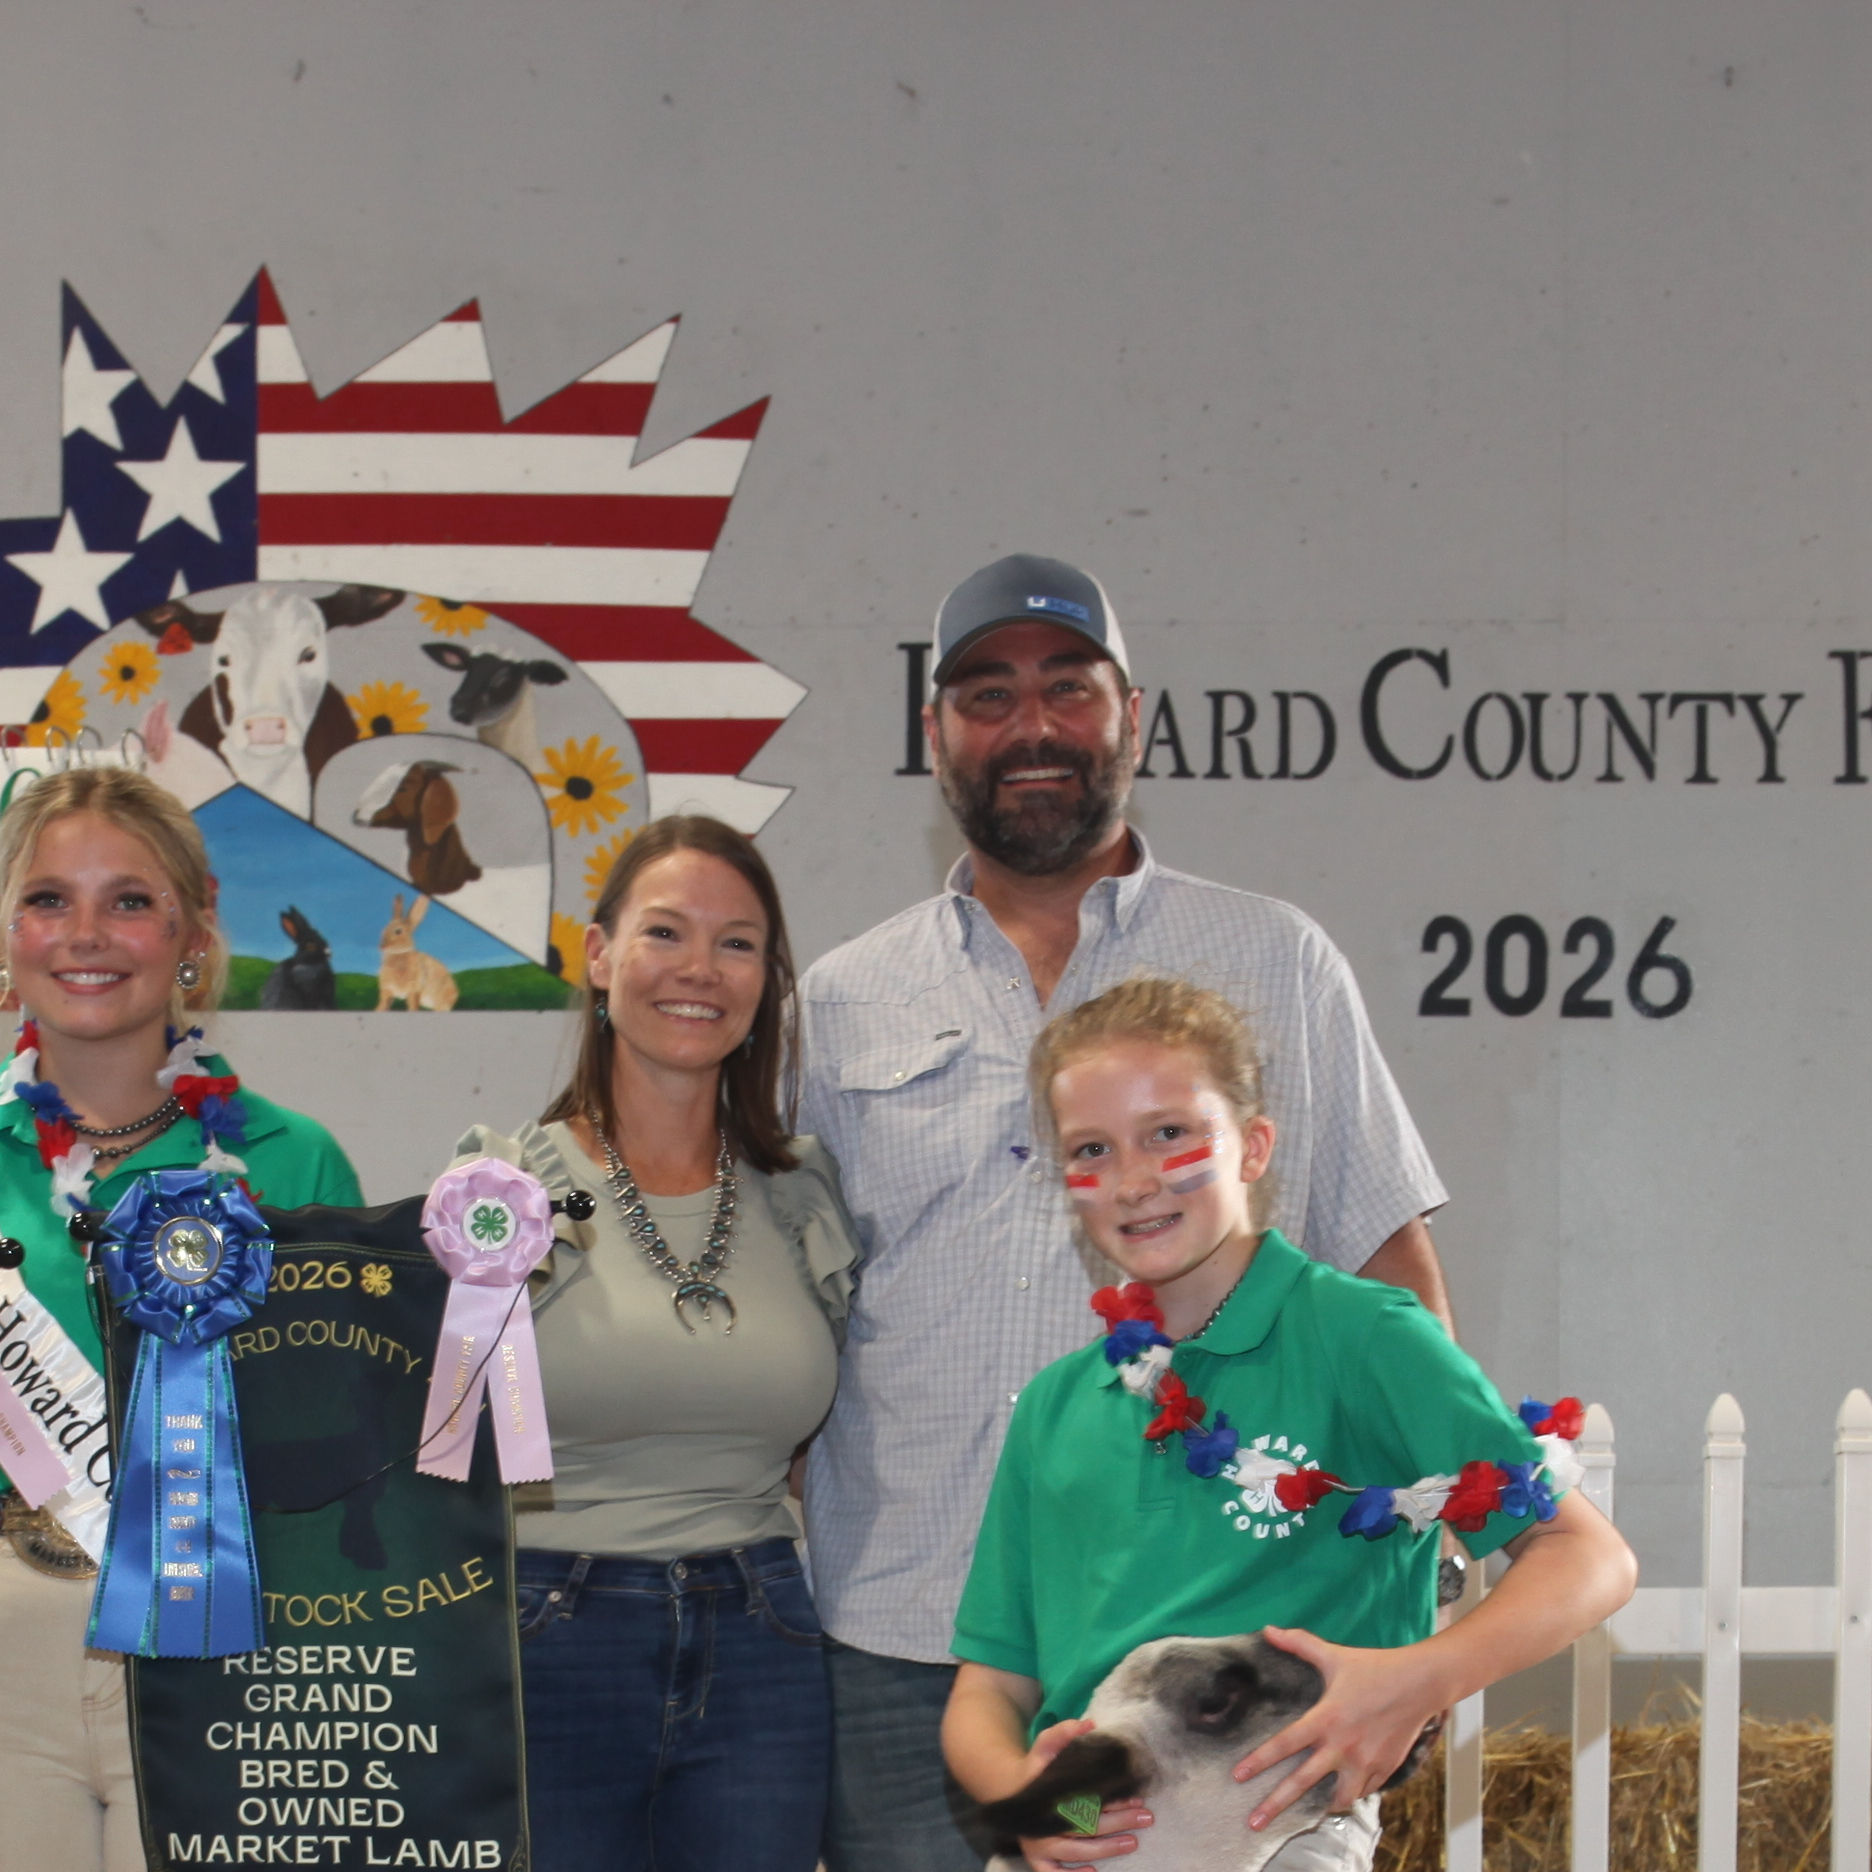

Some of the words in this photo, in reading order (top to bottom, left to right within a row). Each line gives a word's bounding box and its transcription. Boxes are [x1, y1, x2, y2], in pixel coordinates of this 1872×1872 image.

[895, 642, 1336, 780] ARD
[1359, 646, 1805, 784] COUNTY
[1418, 913, 1693, 1019] 2026
[286, 1319, 423, 1375] COUNTY
[1221, 1433, 1321, 1481] HWAR
[1222, 1500, 1316, 1540] COUNT
[262, 1590, 374, 1627] TOCK
[382, 1556, 495, 1618] SALE
[222, 1644, 418, 1677] RESERVE
[243, 1683, 393, 1713] GRAND
[205, 1720, 440, 1754] CHAMPION
[239, 1759, 351, 1789] BRED
[363, 1759, 400, 1790] &
[238, 1796, 406, 1828] OWNED
[167, 1831, 352, 1864] MARKET
[366, 1838, 503, 1870] LAMB
